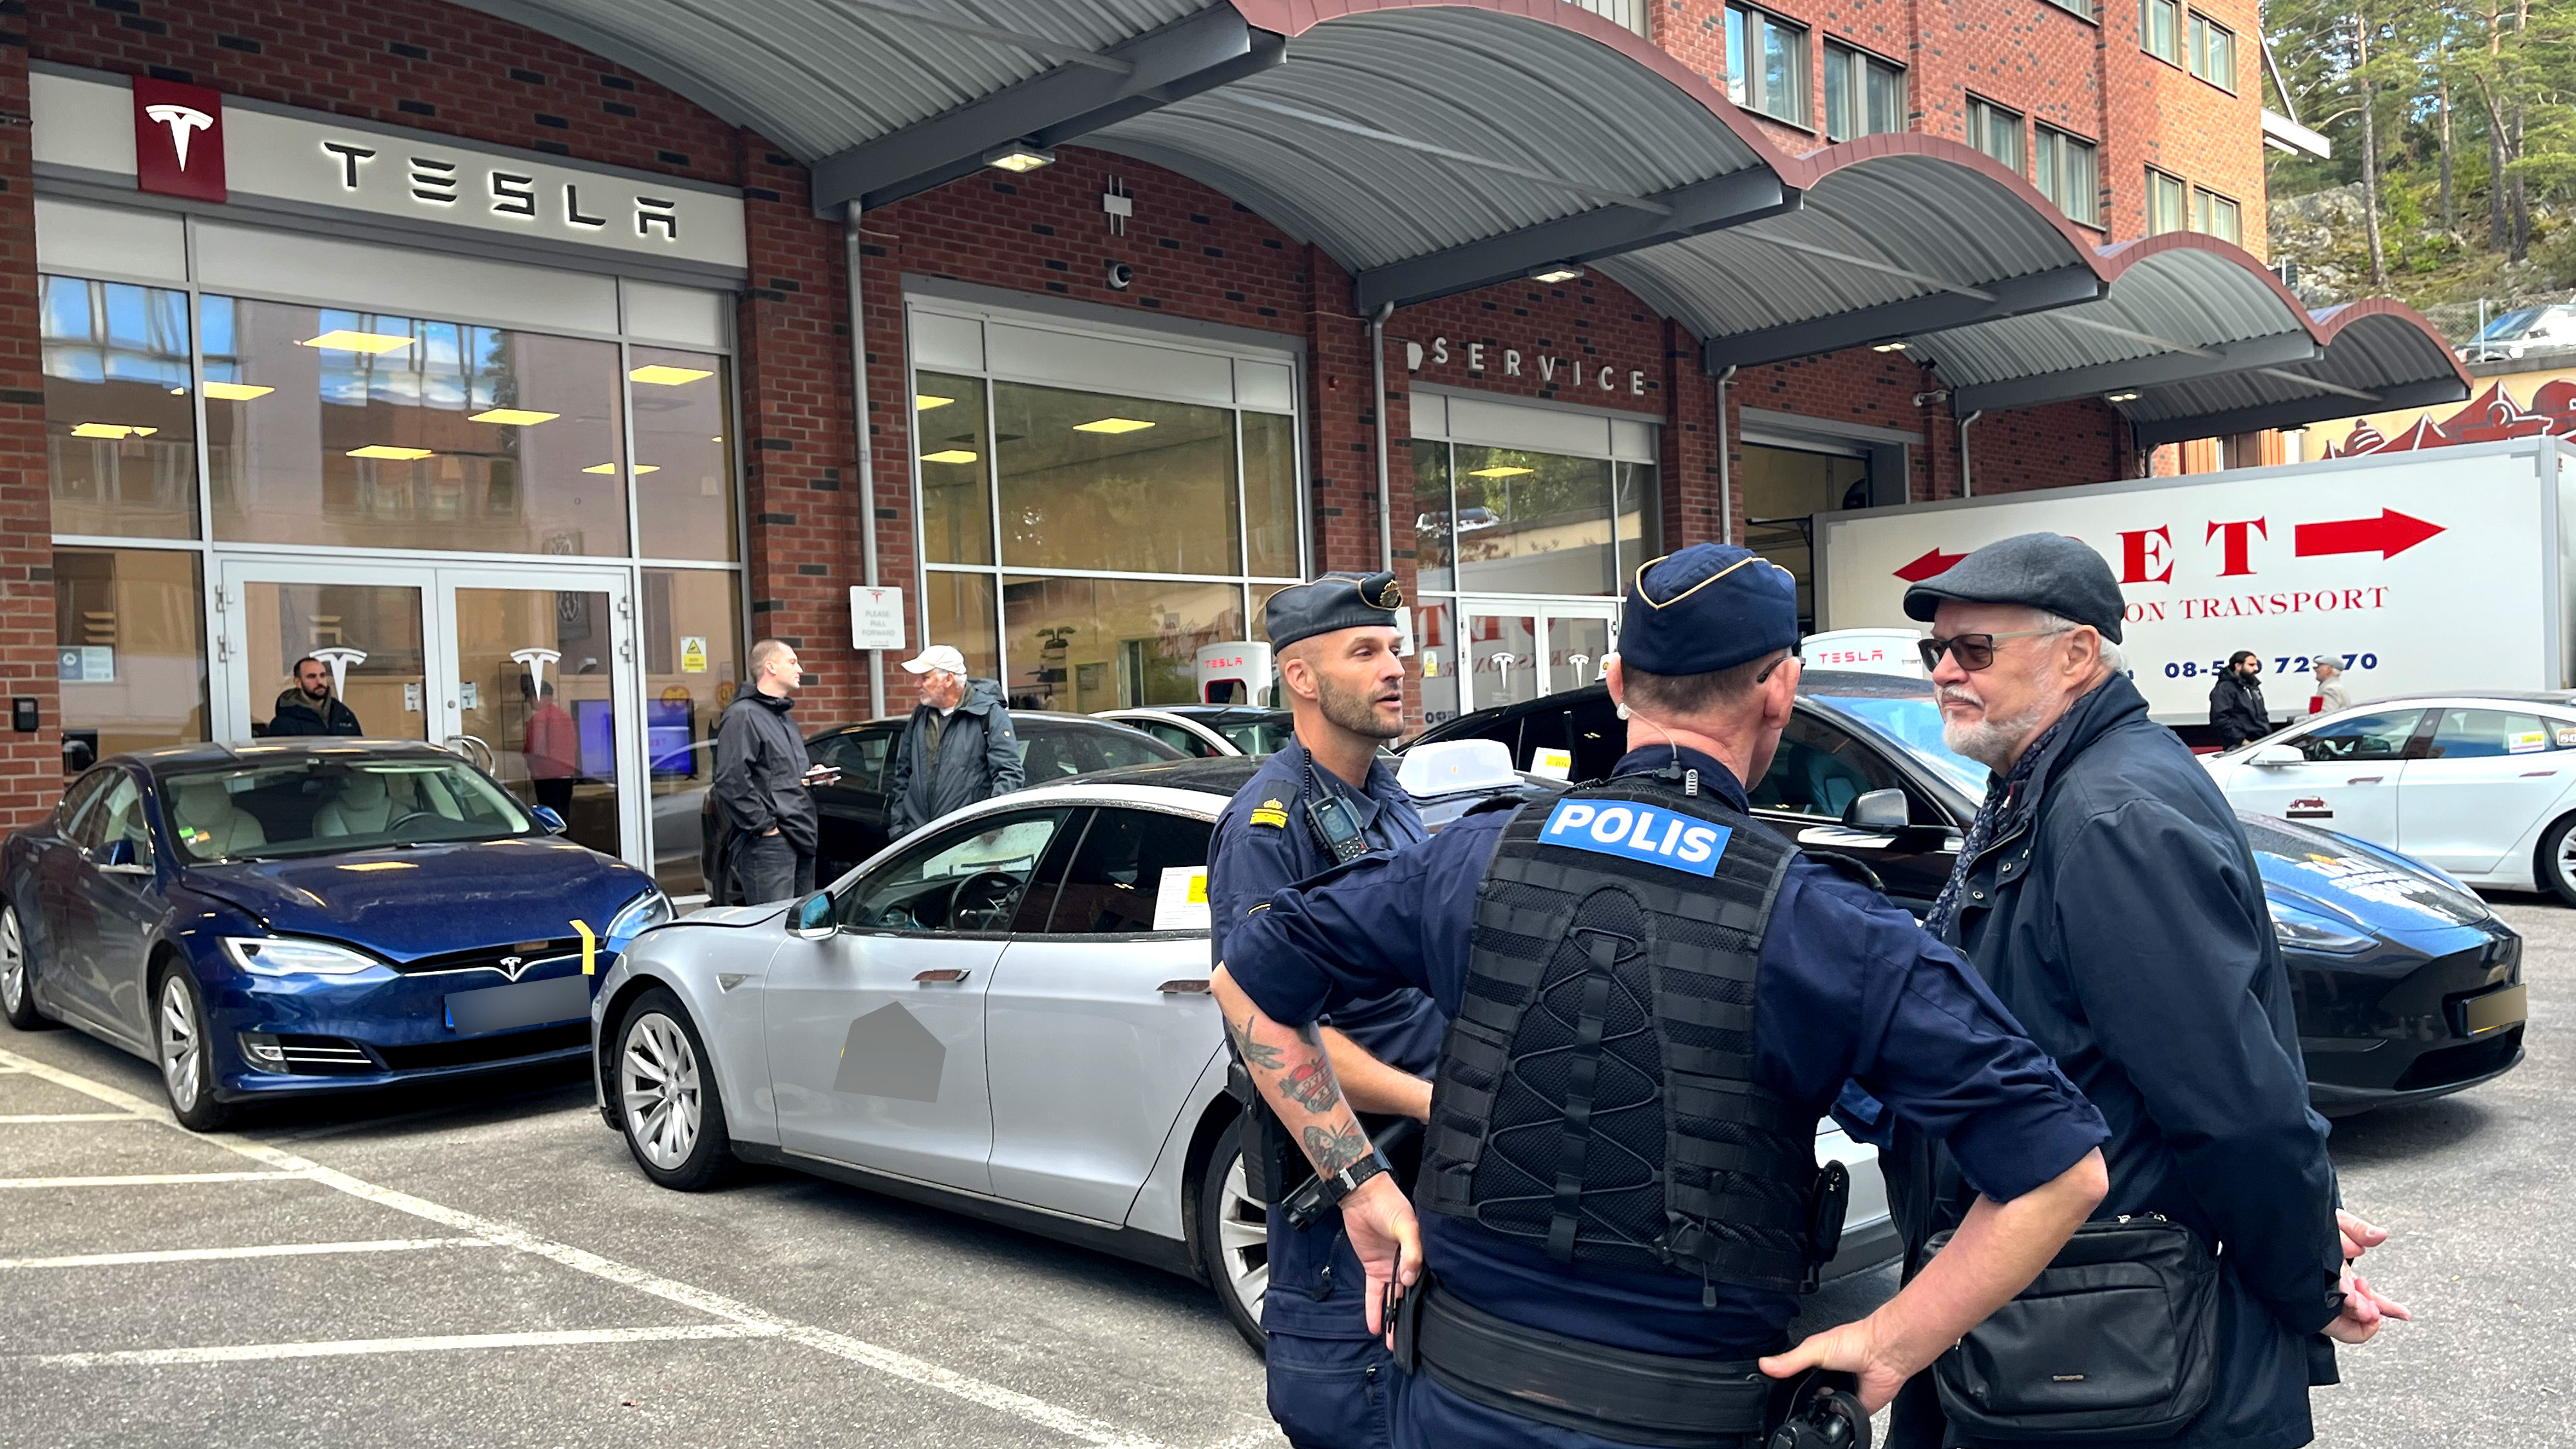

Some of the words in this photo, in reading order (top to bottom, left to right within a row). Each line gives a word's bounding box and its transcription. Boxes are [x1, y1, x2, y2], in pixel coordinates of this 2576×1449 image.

[323, 141, 677, 239] TESLA
[1432, 337, 1644, 395] SERVICE
[2115, 515, 2268, 585] ET
[2125, 601, 2166, 623] ON
[2179, 586, 2390, 619] TRANSPORT
[1204, 657, 1243, 668] TESLA
[1819, 650, 1882, 664] TESLA
[2164, 659, 2262, 678] 08-5
[2275, 655, 2324, 674] 72
[2342, 653, 2377, 670] 70
[1550, 805, 1717, 862] POLIS
